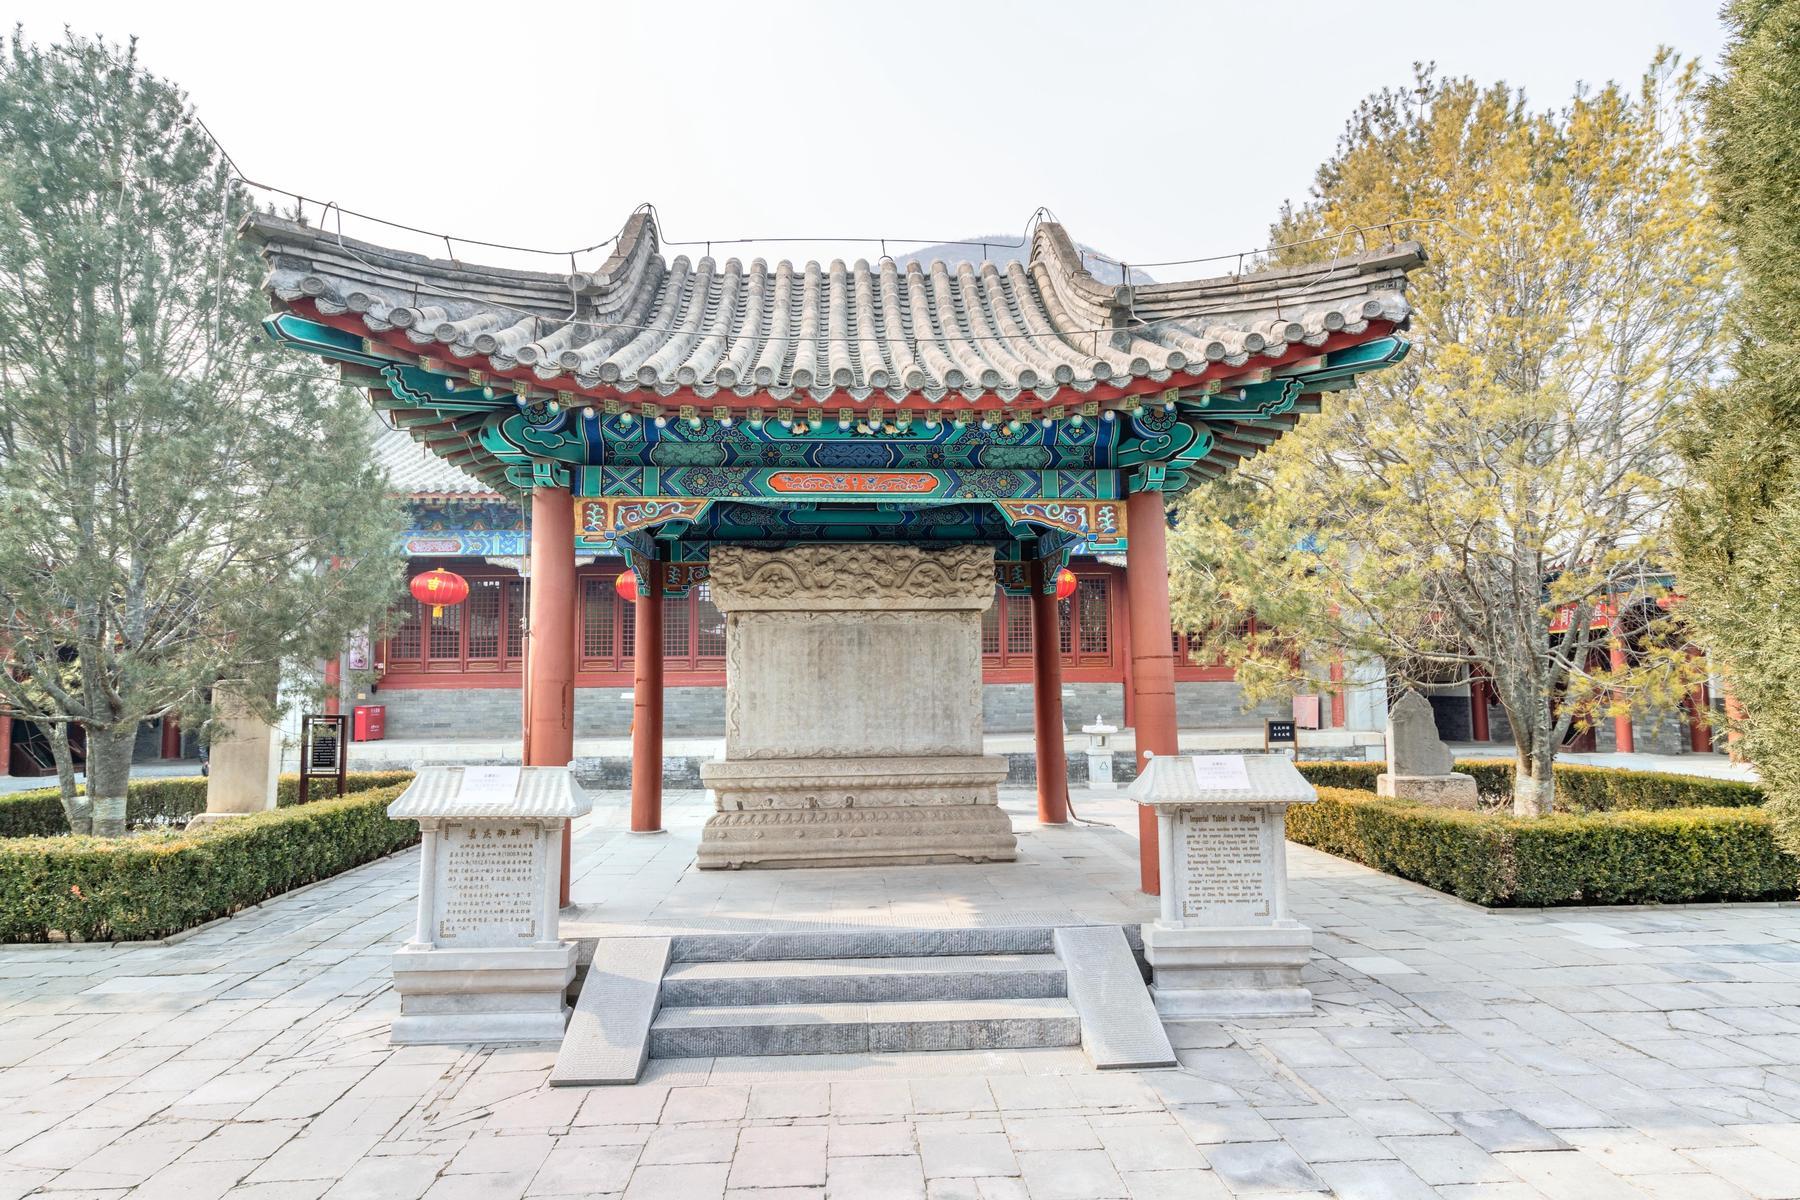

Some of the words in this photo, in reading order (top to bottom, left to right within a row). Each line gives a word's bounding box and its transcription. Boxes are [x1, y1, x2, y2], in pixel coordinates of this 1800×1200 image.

[427, 576, 441, 591] 吉
[1190, 815, 1209, 824] Imperial
[468, 828, 521, 839] 嘉庆御碑
